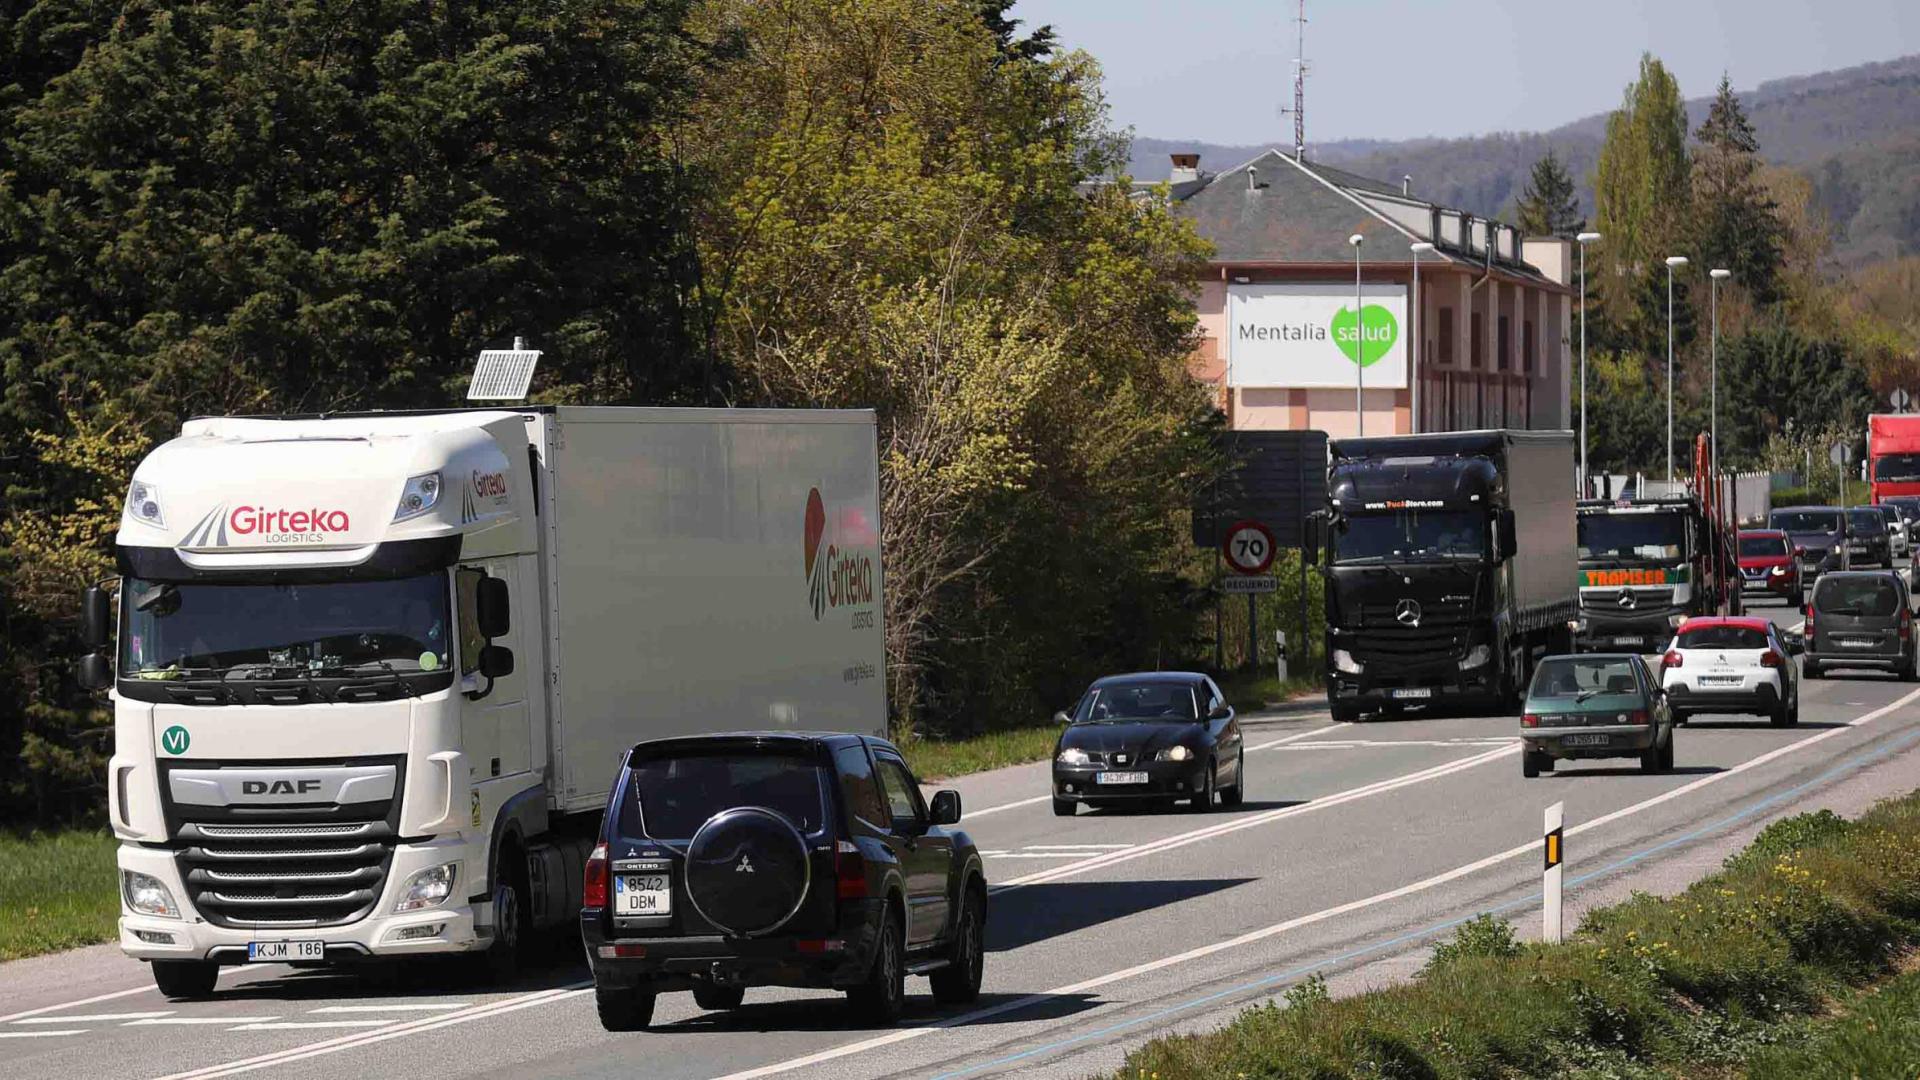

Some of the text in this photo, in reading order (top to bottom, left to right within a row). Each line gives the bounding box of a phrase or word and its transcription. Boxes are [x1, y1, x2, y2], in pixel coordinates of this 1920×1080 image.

[1239, 322, 1392, 342] Mentalia salud
[230, 505, 349, 535] Girteka
[266, 533, 324, 543] LOGISTICS
[1236, 539, 1264, 557] 70
[826, 544, 873, 608] Girteka
[166, 730, 185, 749] VI
[242, 779, 321, 795] DAF
[628, 877, 663, 892] 8542
[630, 895, 656, 909] DBM
[257, 942, 321, 957] KJM 186
